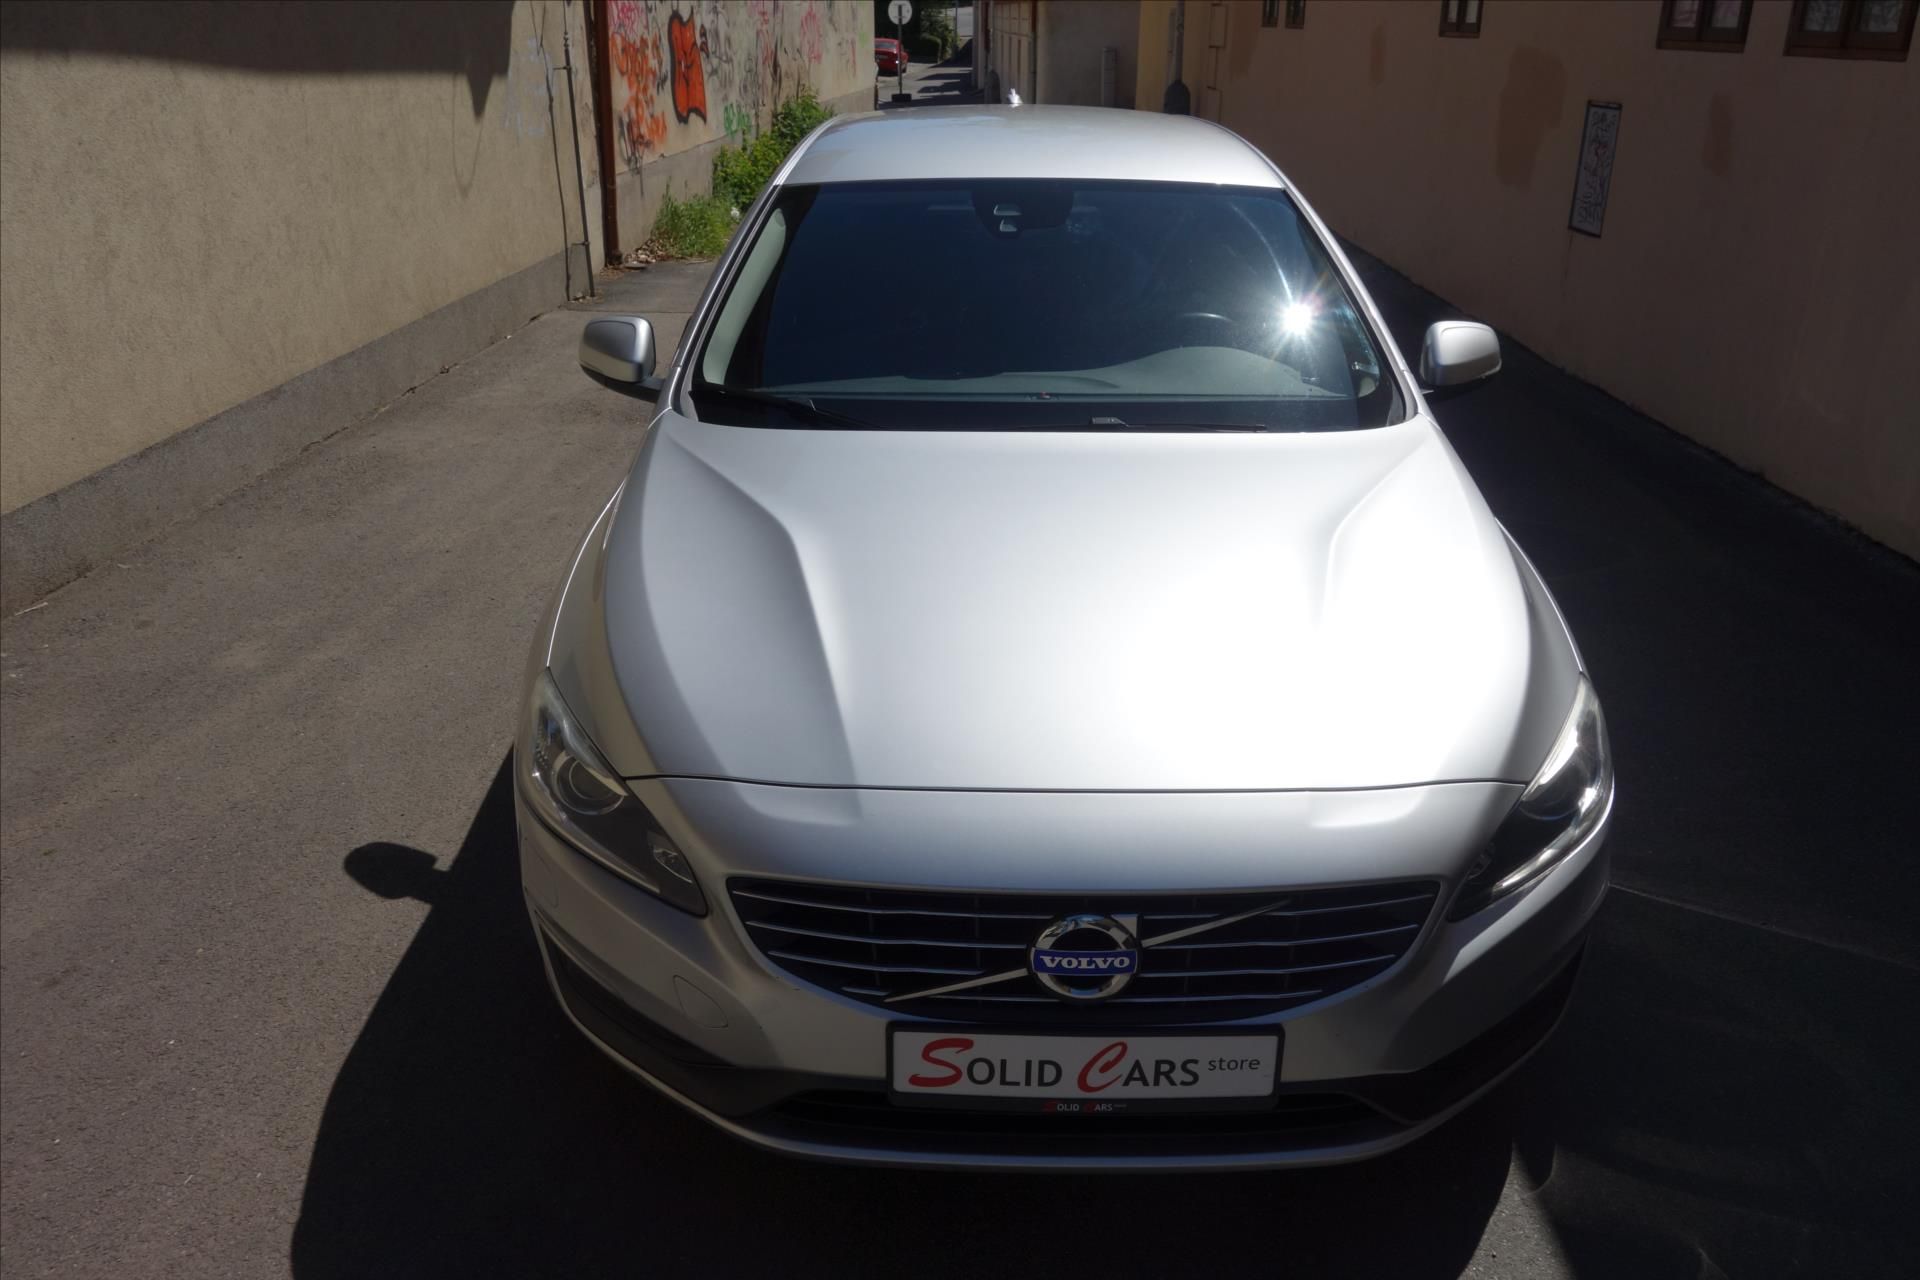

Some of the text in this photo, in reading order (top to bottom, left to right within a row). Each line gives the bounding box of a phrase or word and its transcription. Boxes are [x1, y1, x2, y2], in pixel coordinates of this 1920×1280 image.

[1040, 955, 1130, 969] VOLVO
[908, 1037, 1261, 1093] SOLID CARS store
